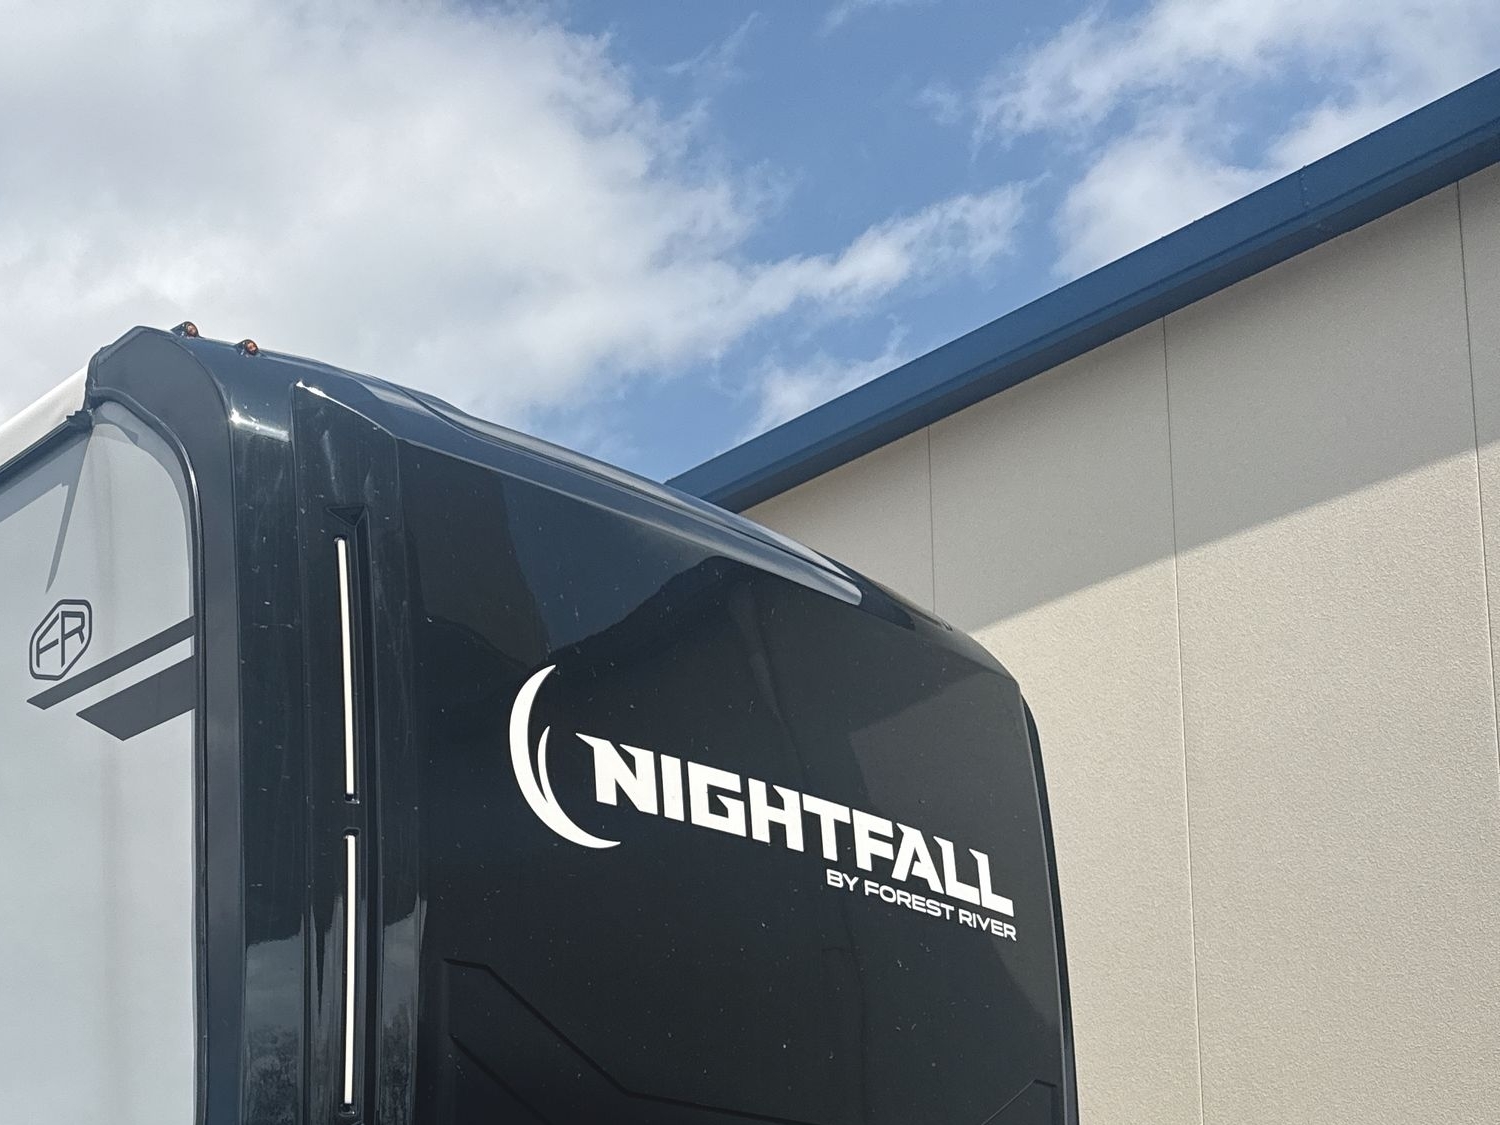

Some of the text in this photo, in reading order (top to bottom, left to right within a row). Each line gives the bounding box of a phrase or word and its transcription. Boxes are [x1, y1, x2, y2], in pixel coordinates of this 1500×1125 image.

[575, 732, 1015, 917] NIGHTFALL
[825, 868, 1018, 942] BY FOREST RIVER
